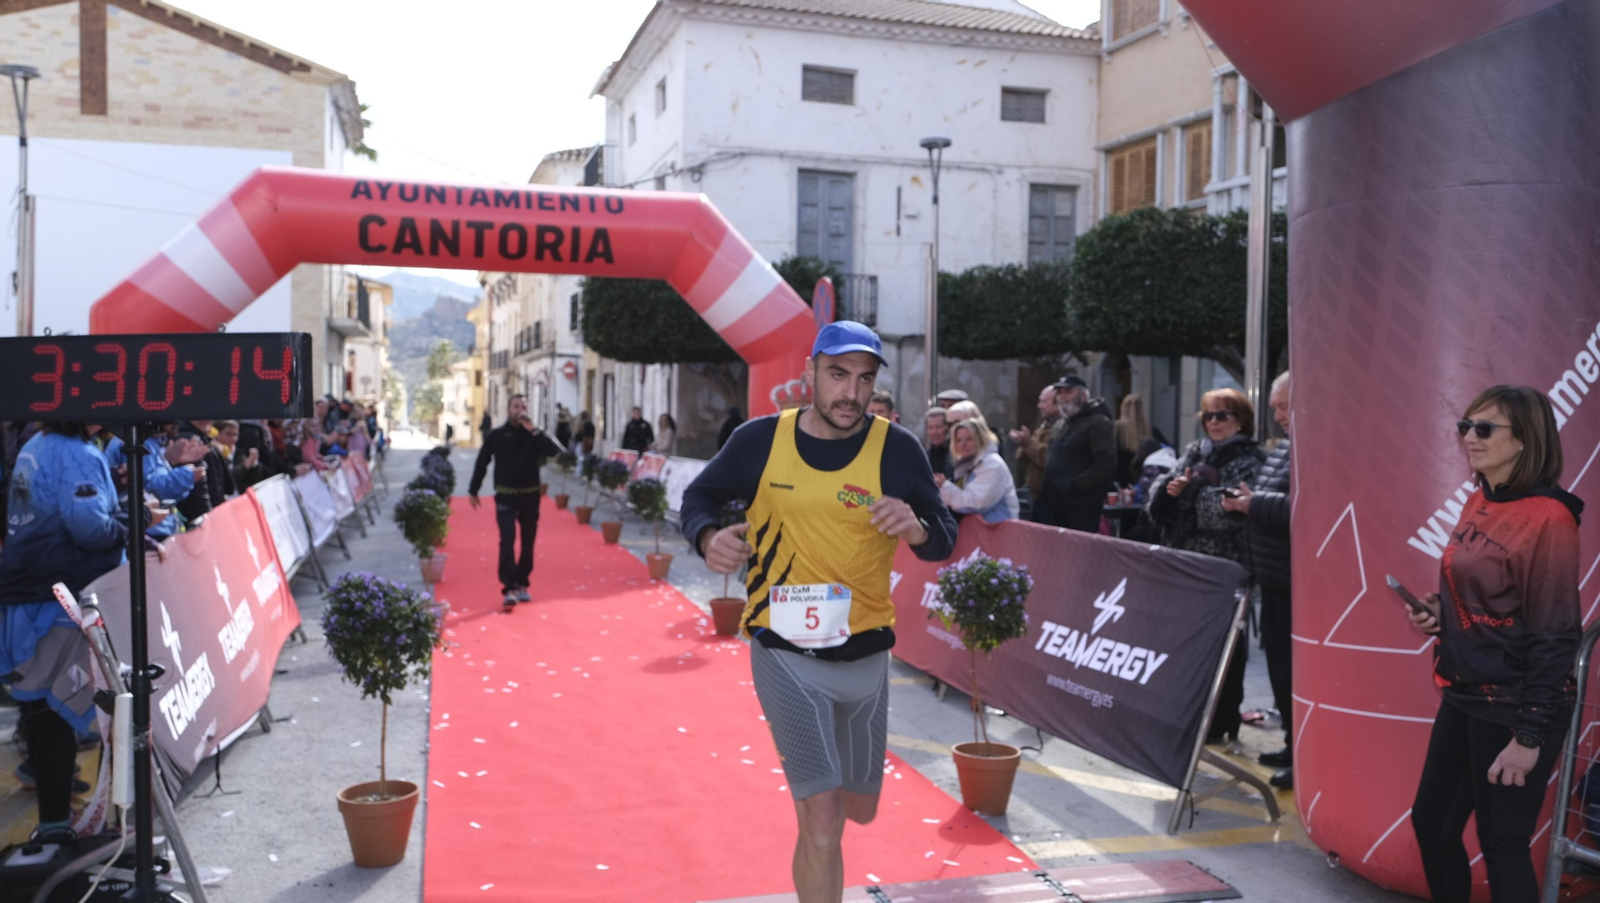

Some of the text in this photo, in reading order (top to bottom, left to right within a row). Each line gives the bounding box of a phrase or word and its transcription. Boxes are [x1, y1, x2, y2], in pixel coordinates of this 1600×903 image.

[351, 180, 624, 214] AYUNTAMIENTO
[358, 214, 614, 264] CANTORIA
[805, 606, 820, 630] 5
[1034, 620, 1169, 685] TEAMERGY
[159, 651, 215, 741] TEAMERGY
